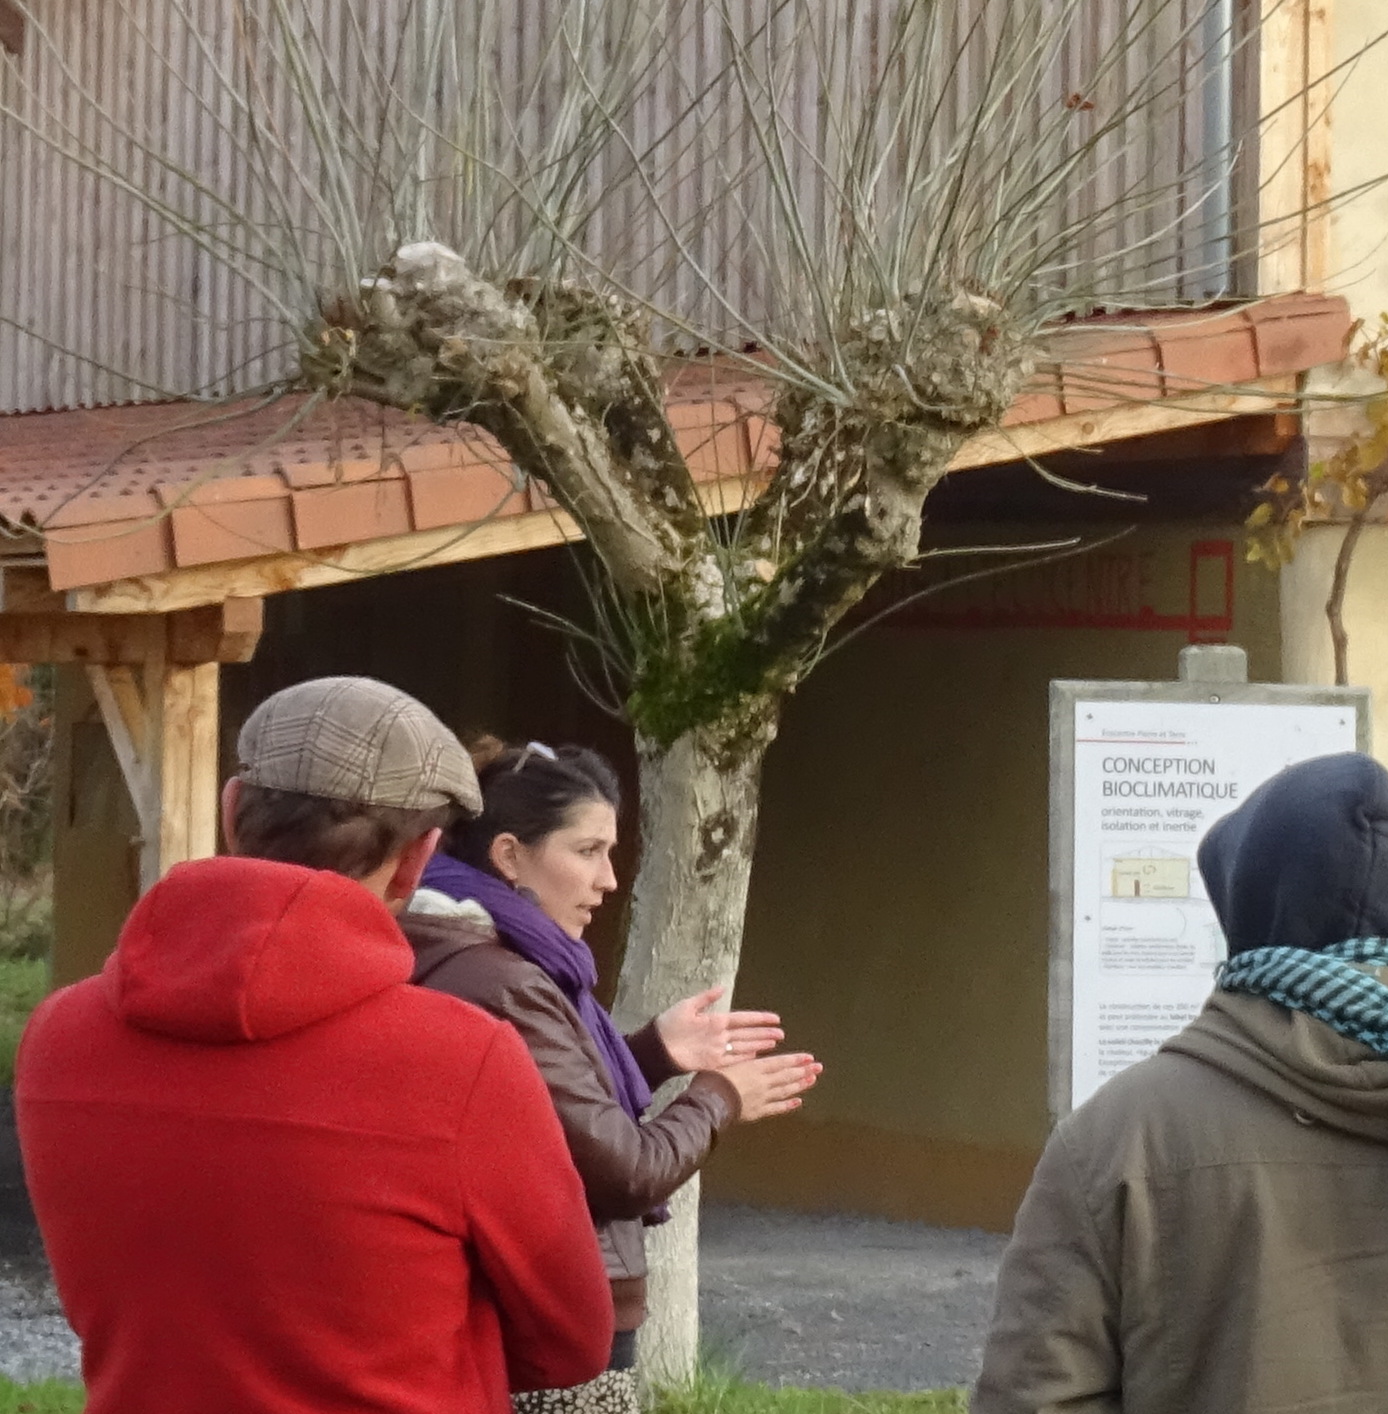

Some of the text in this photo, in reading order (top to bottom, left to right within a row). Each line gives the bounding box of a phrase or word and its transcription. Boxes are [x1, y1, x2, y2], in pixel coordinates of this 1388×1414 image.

[1102, 757, 1216, 775] CONCEPTION
[1102, 780, 1239, 800] BIOCLIMATIQUE
[1101, 807, 1163, 819] orientation,
[1101, 821, 1197, 833] isolation et inertie
